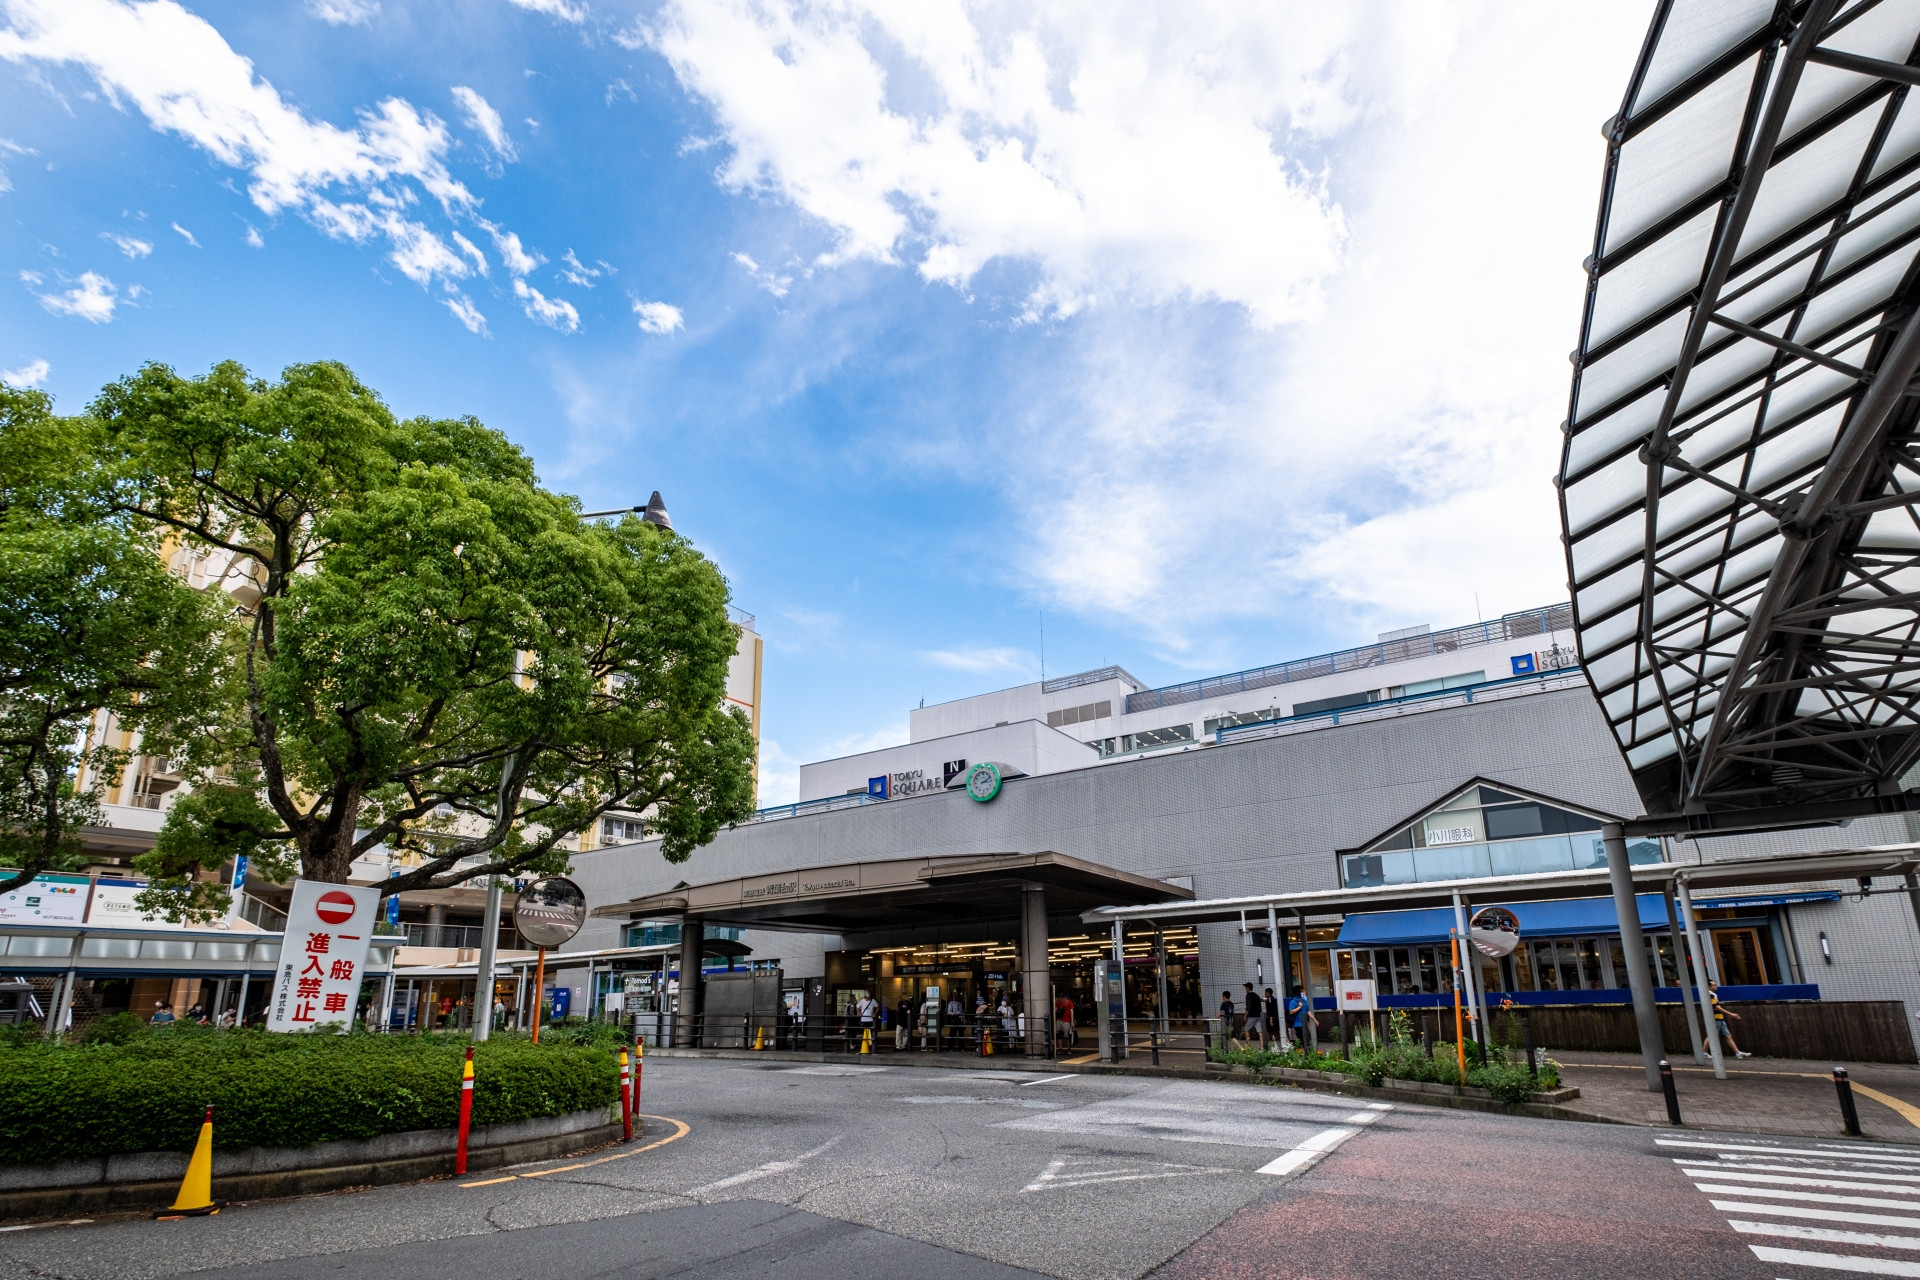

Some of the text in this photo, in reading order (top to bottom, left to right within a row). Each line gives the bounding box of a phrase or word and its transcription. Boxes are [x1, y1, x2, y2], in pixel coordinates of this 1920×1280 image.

[893, 769, 923, 781] TOKYU
[949, 761, 959, 773] N
[893, 777, 941, 796] SQUARE
[1430, 827, 1473, 843] 小川眼科
[292, 932, 331, 1022] 進入禁止
[323, 934, 360, 1013] 一般車
[276, 964, 293, 1021] 東急バス株式会社
